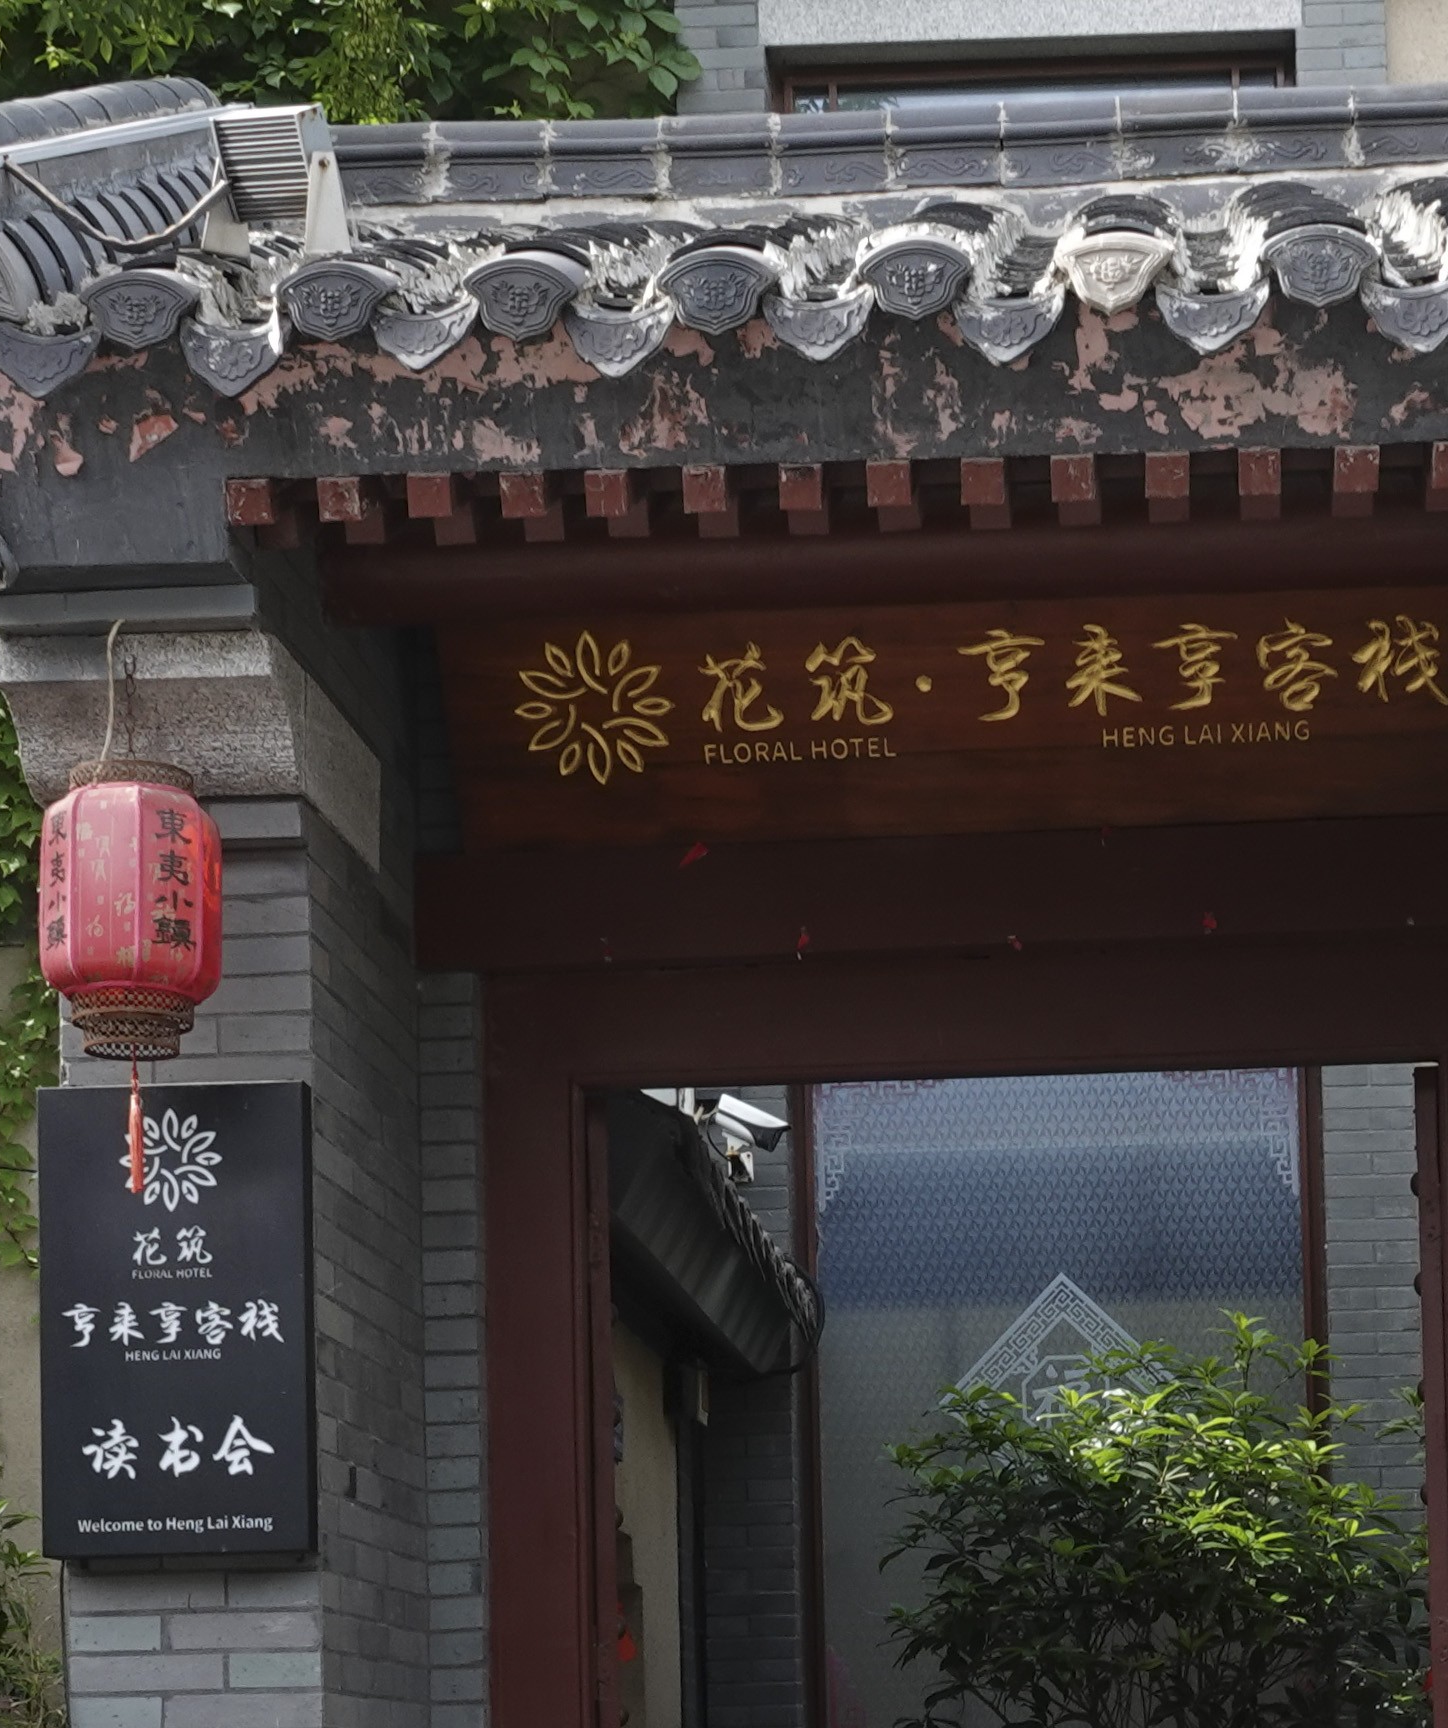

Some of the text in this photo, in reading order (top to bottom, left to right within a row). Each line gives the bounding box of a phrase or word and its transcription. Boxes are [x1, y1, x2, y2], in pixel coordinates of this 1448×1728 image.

[1101, 720, 1311, 748] HENG LAI XIANG
[703, 737, 897, 765] FLORAL HOTEL
[132, 1225, 213, 1266] 花筑
[132, 1267, 213, 1280] FLORAL HOTEL
[125, 1348, 221, 1362] HENG LAI XIANG
[81, 1414, 276, 1480] 读书会
[77, 1515, 273, 1533] Welcome to Heng Lai Xiang
